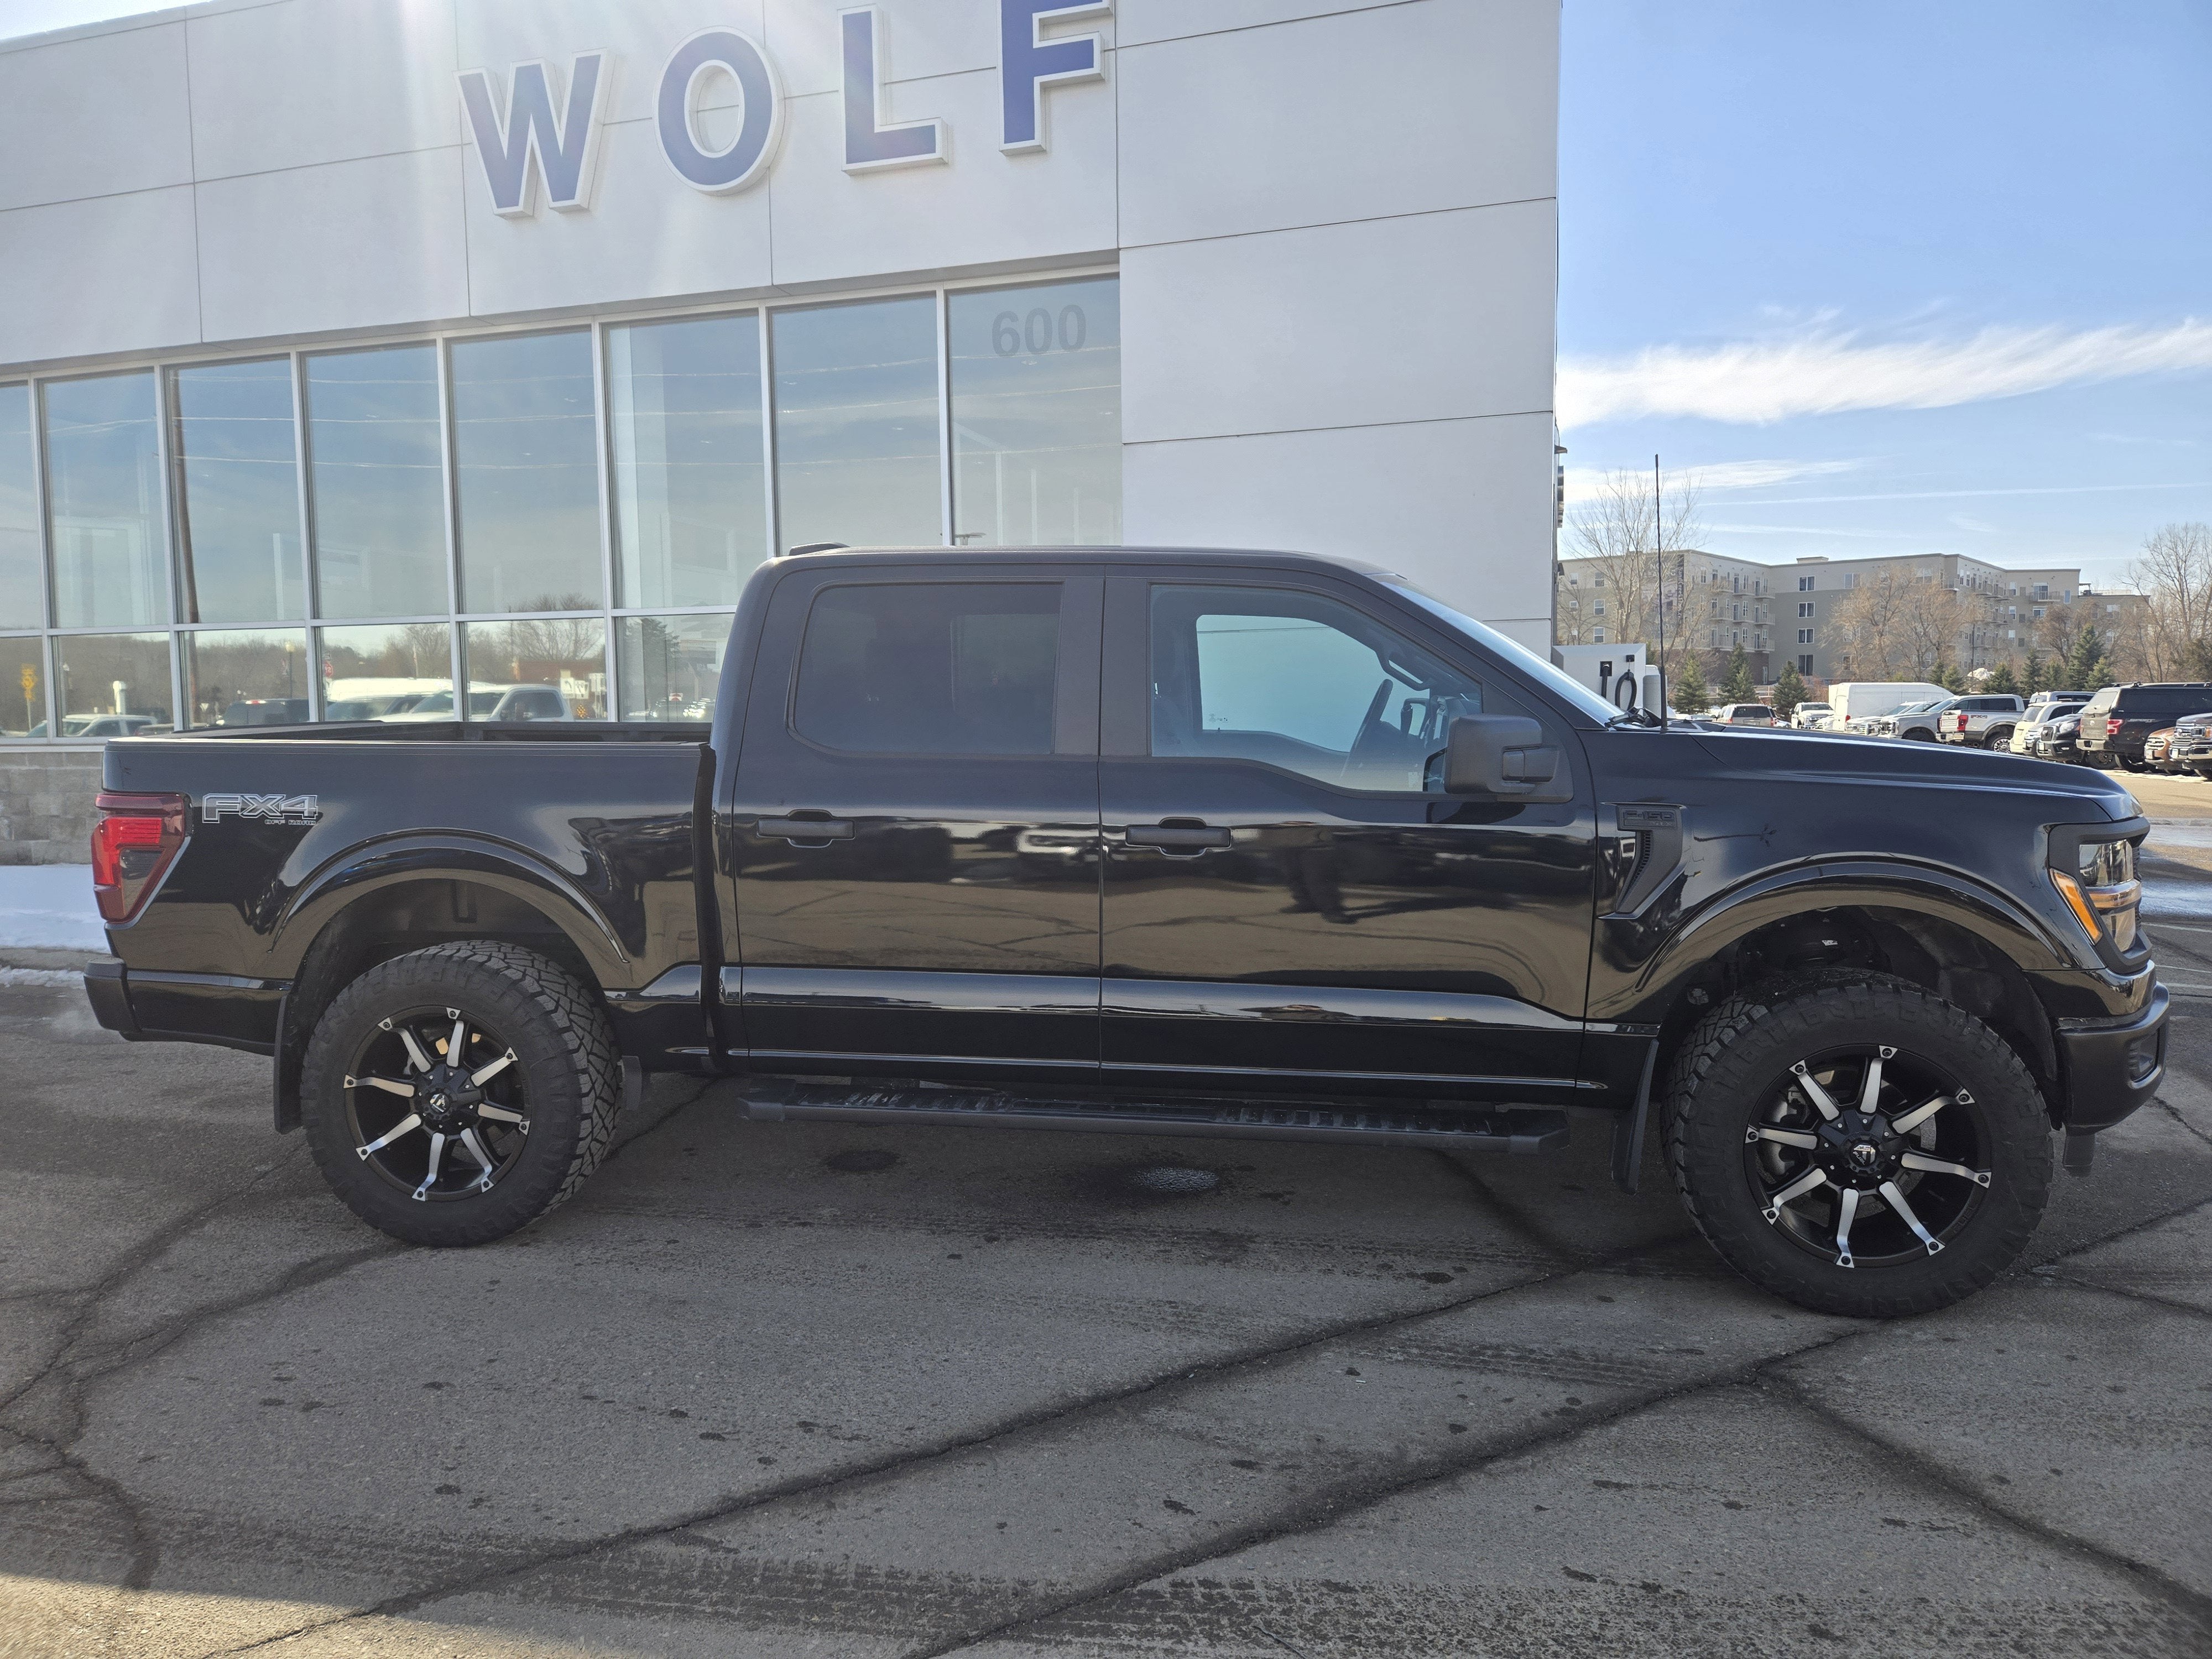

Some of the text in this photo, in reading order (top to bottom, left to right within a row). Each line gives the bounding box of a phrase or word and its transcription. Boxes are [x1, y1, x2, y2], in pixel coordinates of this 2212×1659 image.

[455, 0, 1113, 218] WOLF
[992, 304, 1086, 357] 600
[203, 794, 318, 823] FX4
[1623, 810, 1674, 821] F-150
